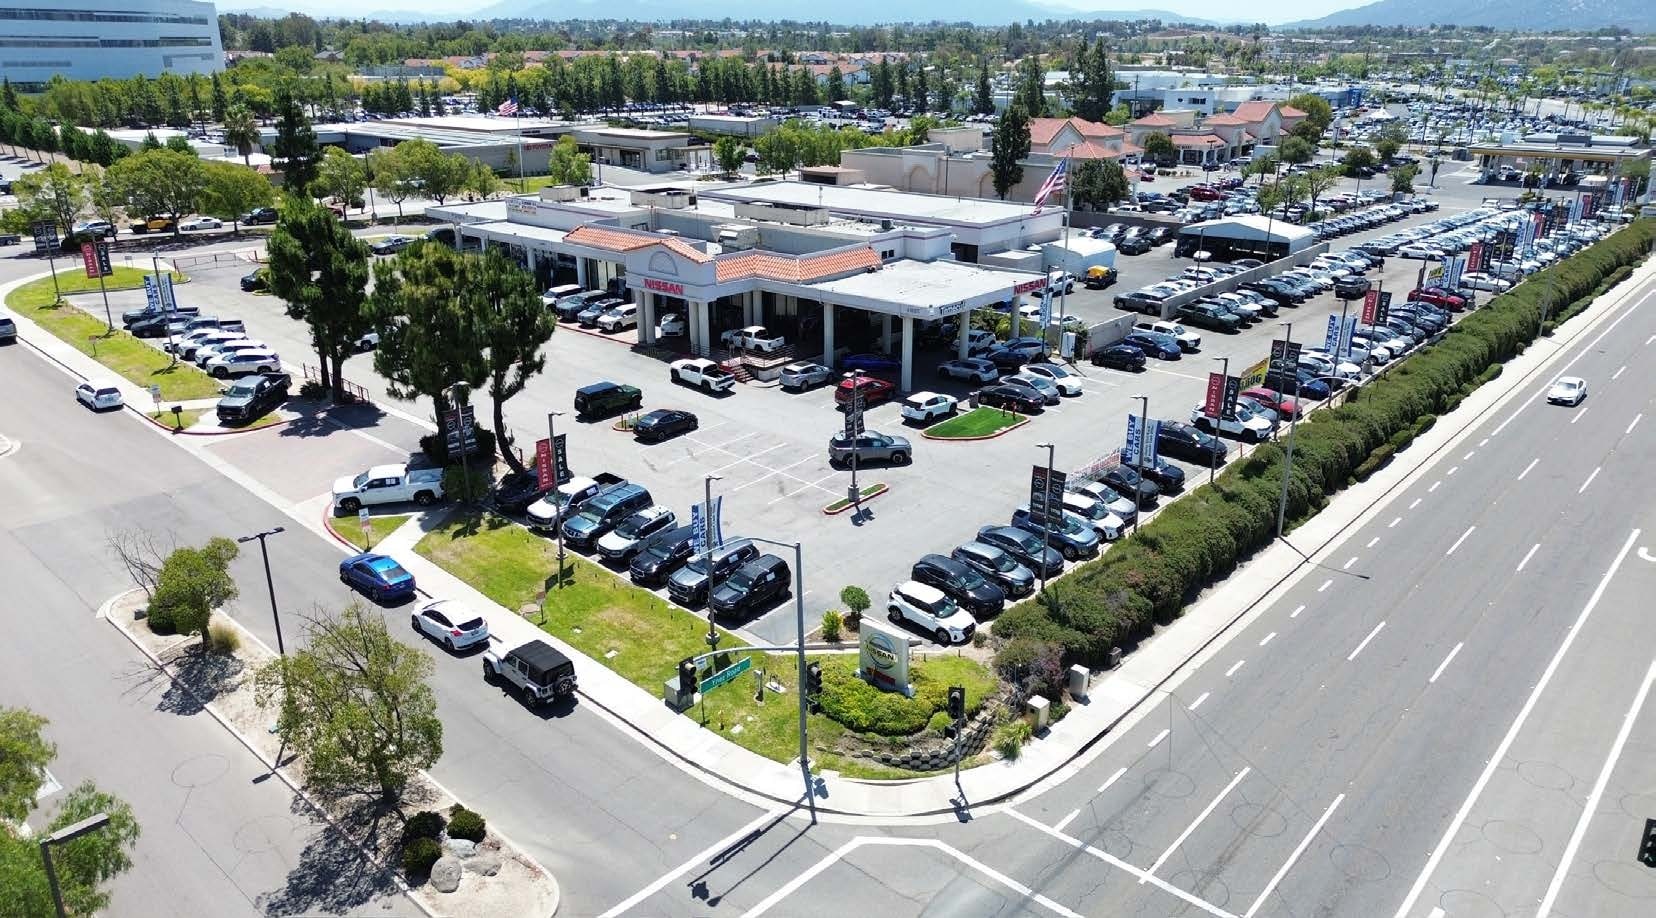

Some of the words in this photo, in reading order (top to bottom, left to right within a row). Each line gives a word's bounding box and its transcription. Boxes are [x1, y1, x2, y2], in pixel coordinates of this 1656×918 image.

[644, 279, 684, 296] NISSAN
[1013, 278, 1047, 296] NISSAN
[1226, 389, 1235, 415] SALE
[1127, 419, 1135, 441] BUY
[1133, 428, 1141, 455] CARS
[557, 449, 565, 477] SALE
[865, 643, 894, 661] NISSAN
[726, 665, 741, 678] Road
